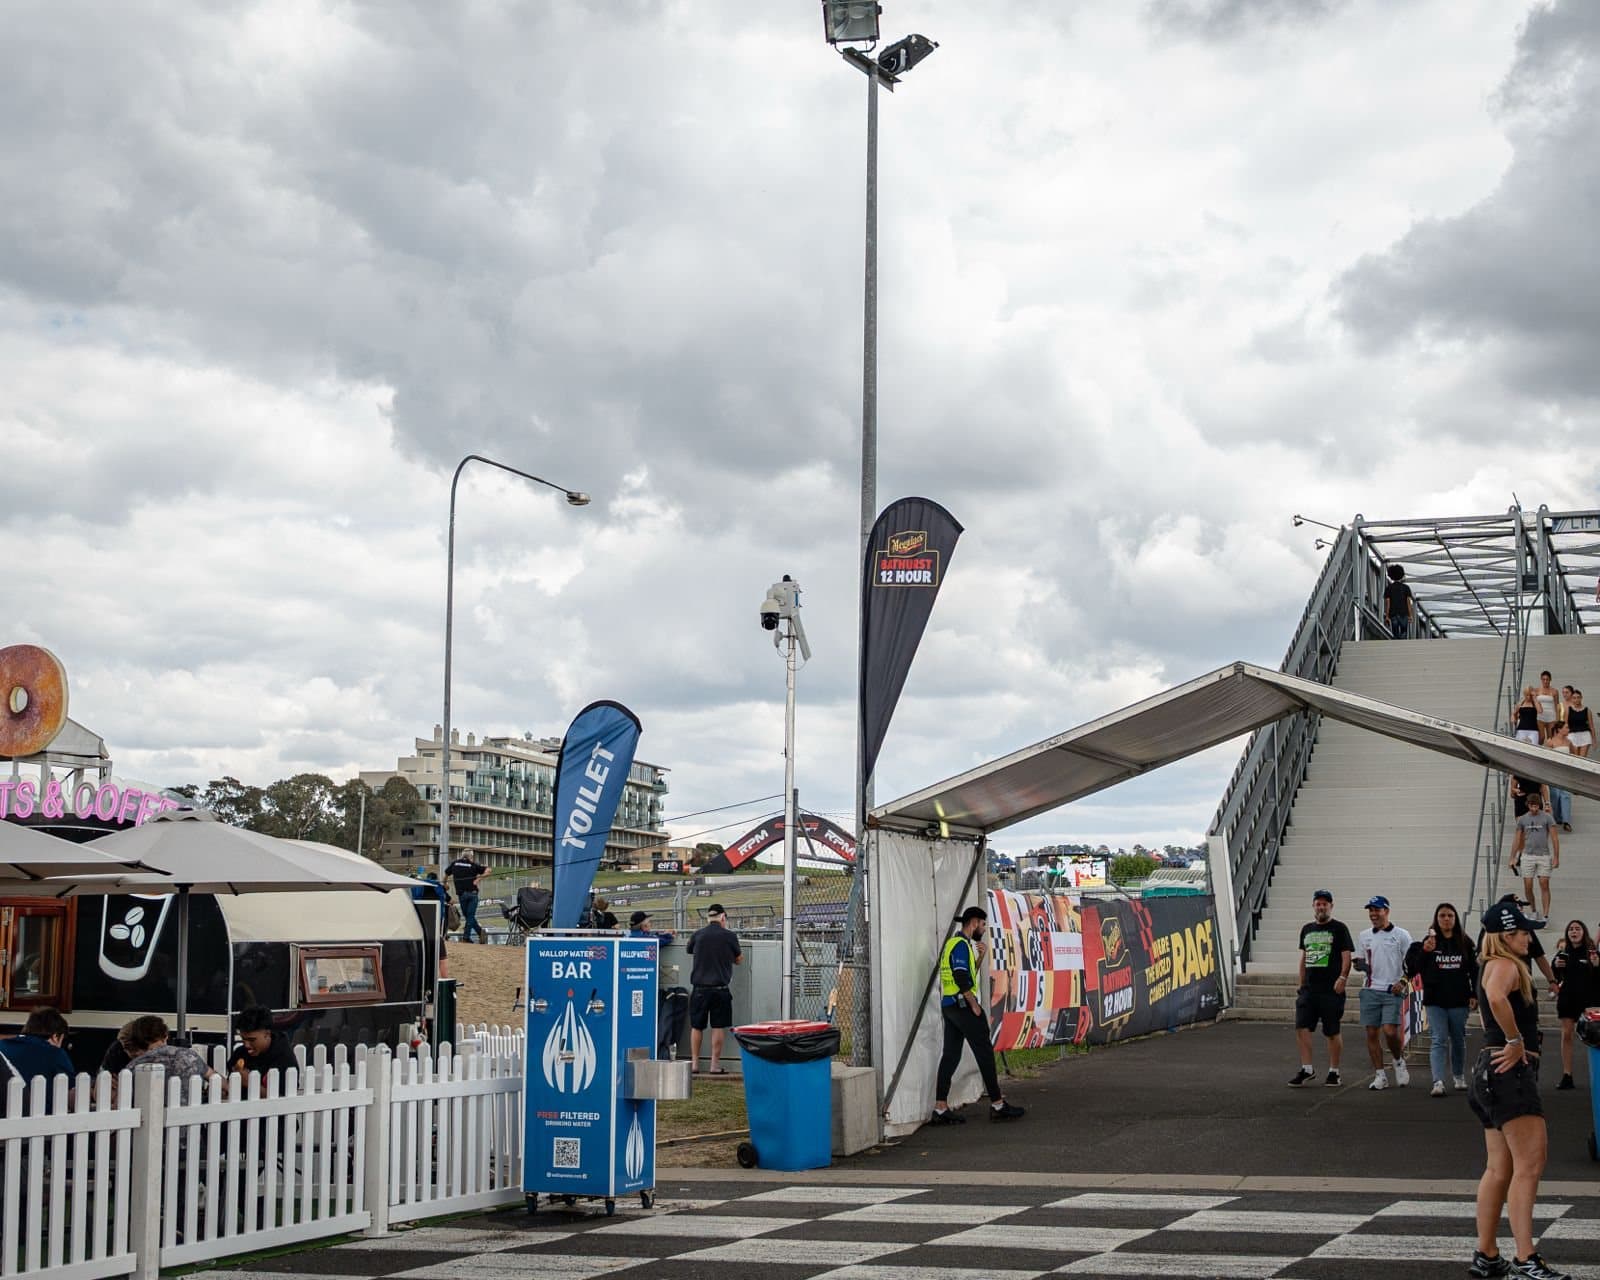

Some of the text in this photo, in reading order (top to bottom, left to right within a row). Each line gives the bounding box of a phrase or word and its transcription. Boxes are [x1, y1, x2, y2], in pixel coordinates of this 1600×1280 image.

[881, 558, 932, 570] BATHURST
[880, 570, 932, 583] 12 HOUR
[42, 780, 65, 819] &
[561, 741, 614, 849] TOILET
[738, 829, 769, 856] RPM
[539, 950, 595, 958] WALLOP WATER
[1170, 919, 1215, 990] RACE
[551, 961, 592, 979] BAR
[1104, 986, 1133, 1018] 12 HOUR
[537, 1111, 600, 1120] FREE FILTERED
